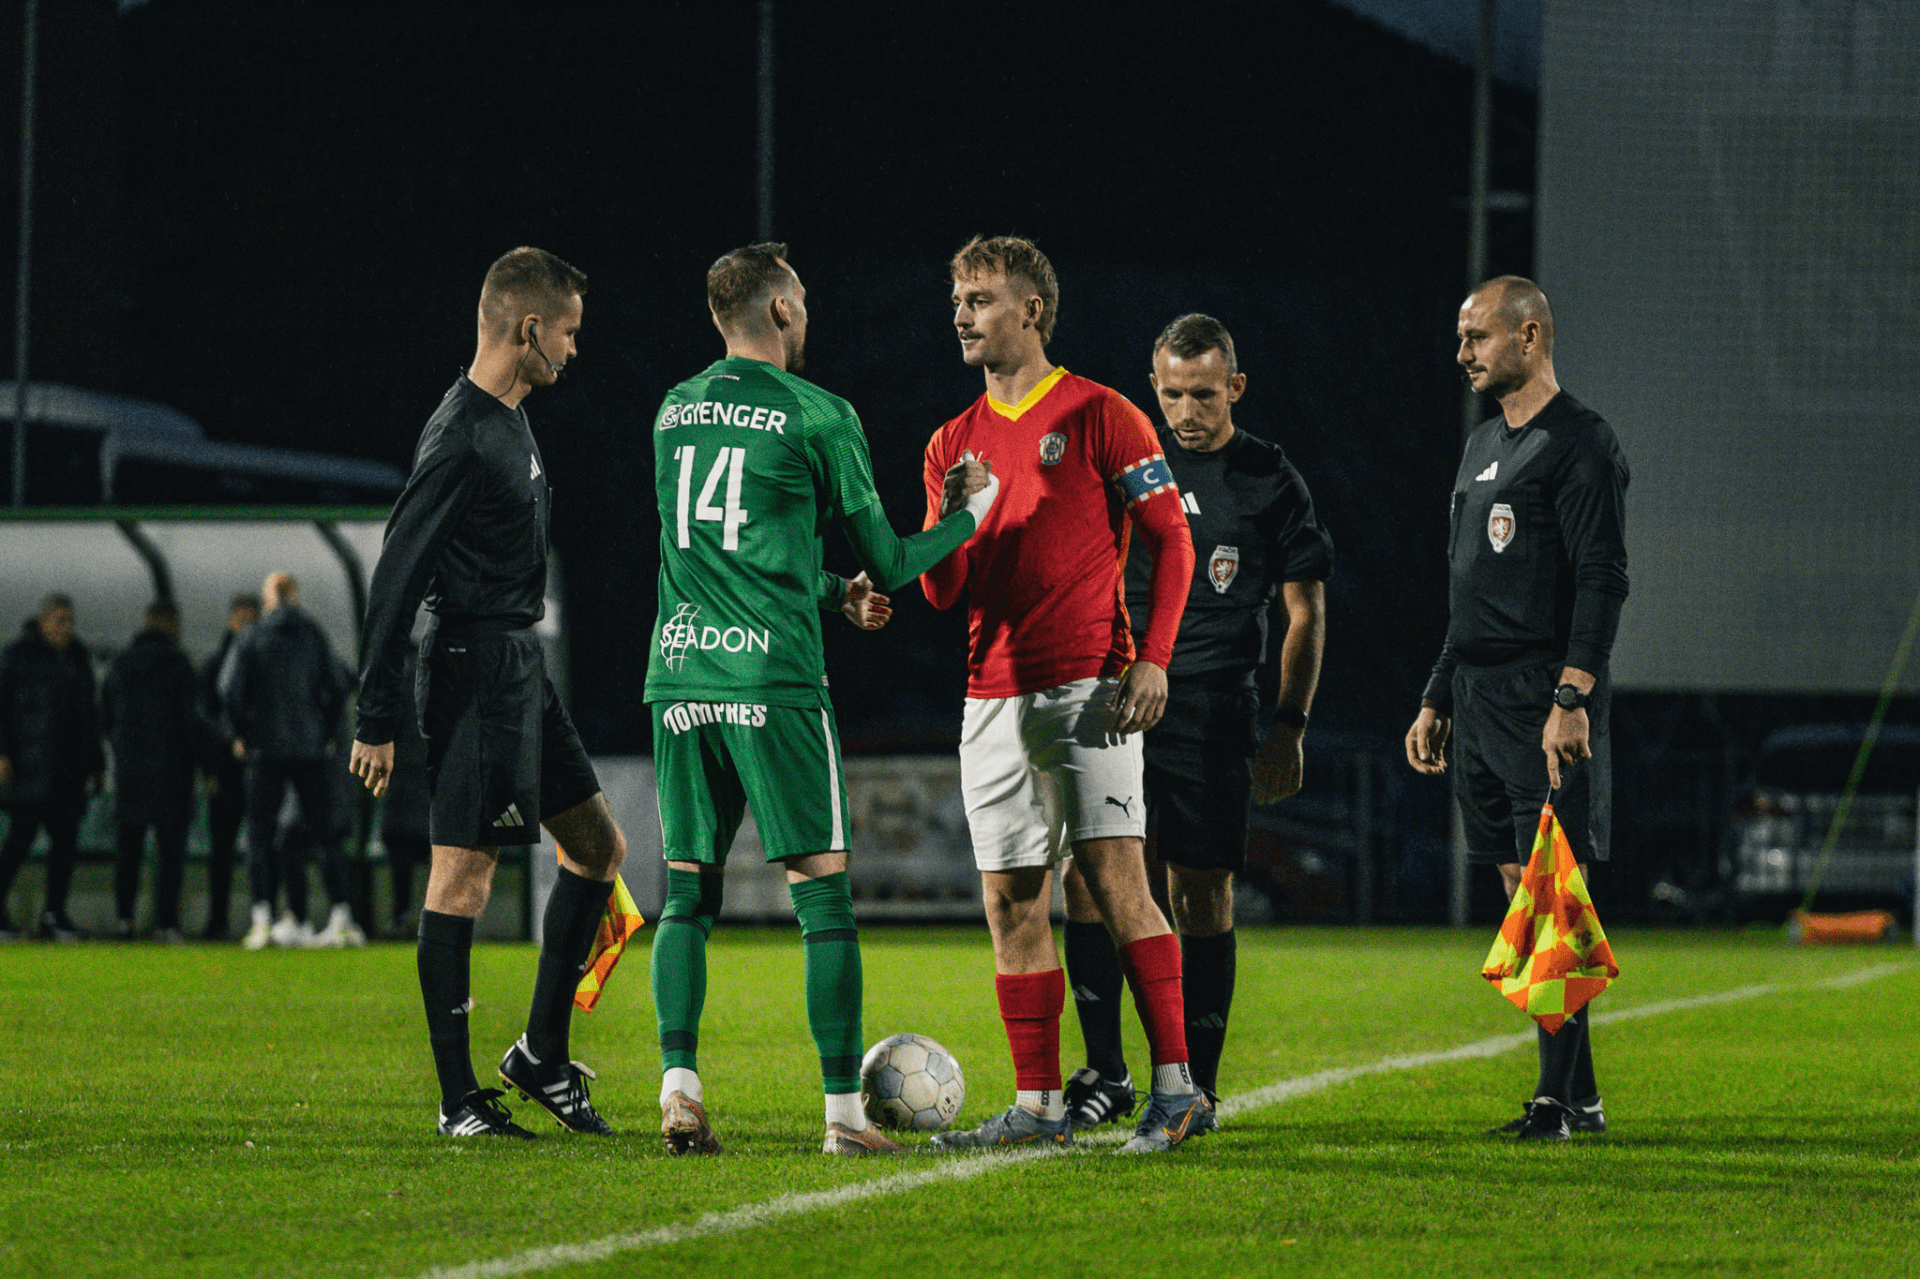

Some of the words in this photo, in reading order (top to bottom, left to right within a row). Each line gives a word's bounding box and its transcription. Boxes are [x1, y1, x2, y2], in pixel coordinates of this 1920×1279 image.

[680, 402, 787, 435] GIENGER
[1142, 467, 1160, 485] C
[673, 445, 748, 551] 14
[659, 623, 769, 654] SEADON
